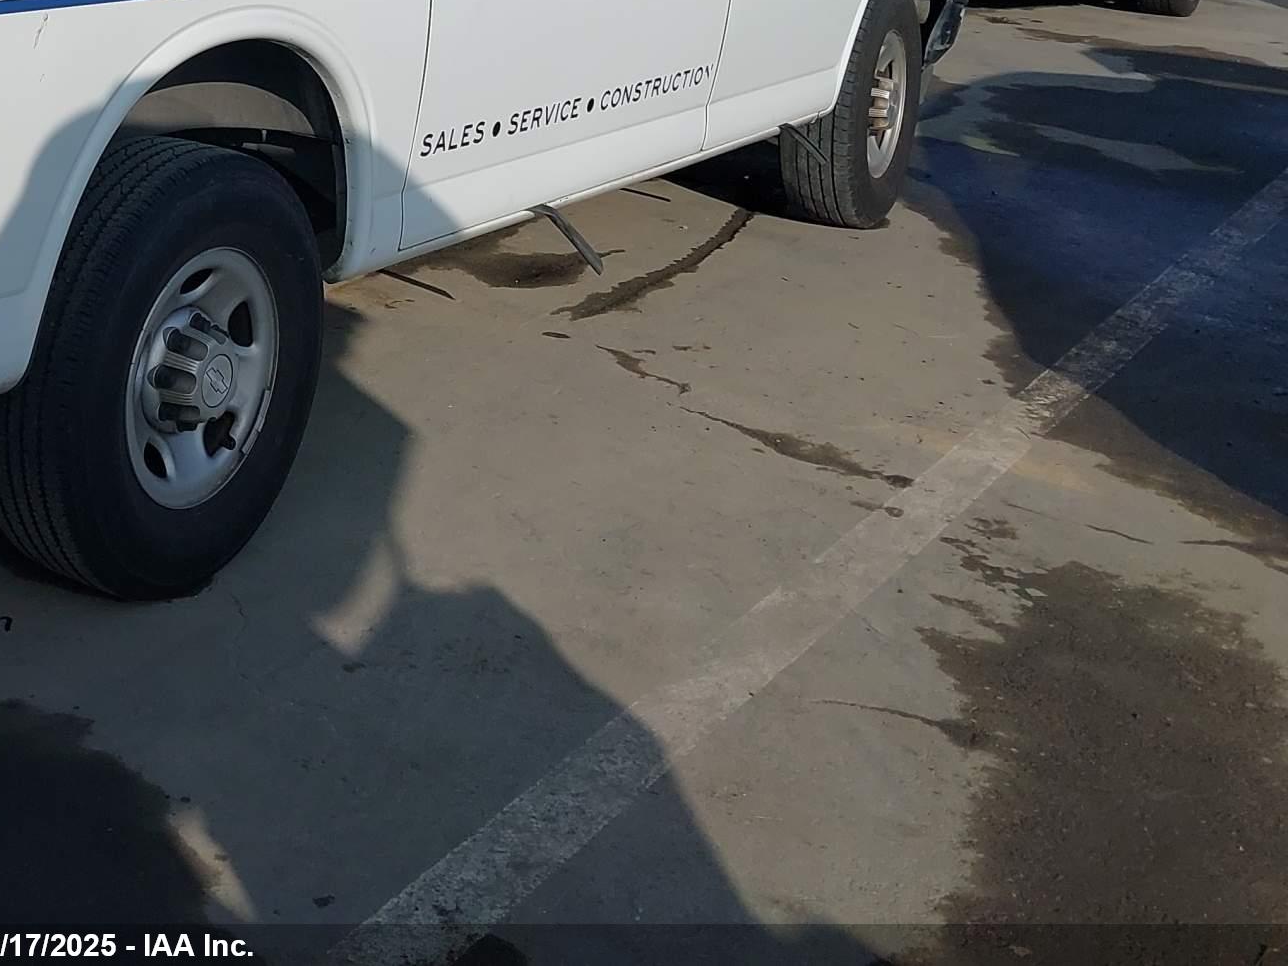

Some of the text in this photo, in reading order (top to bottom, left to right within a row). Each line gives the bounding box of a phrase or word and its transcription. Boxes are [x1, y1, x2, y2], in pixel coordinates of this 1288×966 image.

[420, 63, 714, 158] SALES SERVICE CONSTRUCTION
